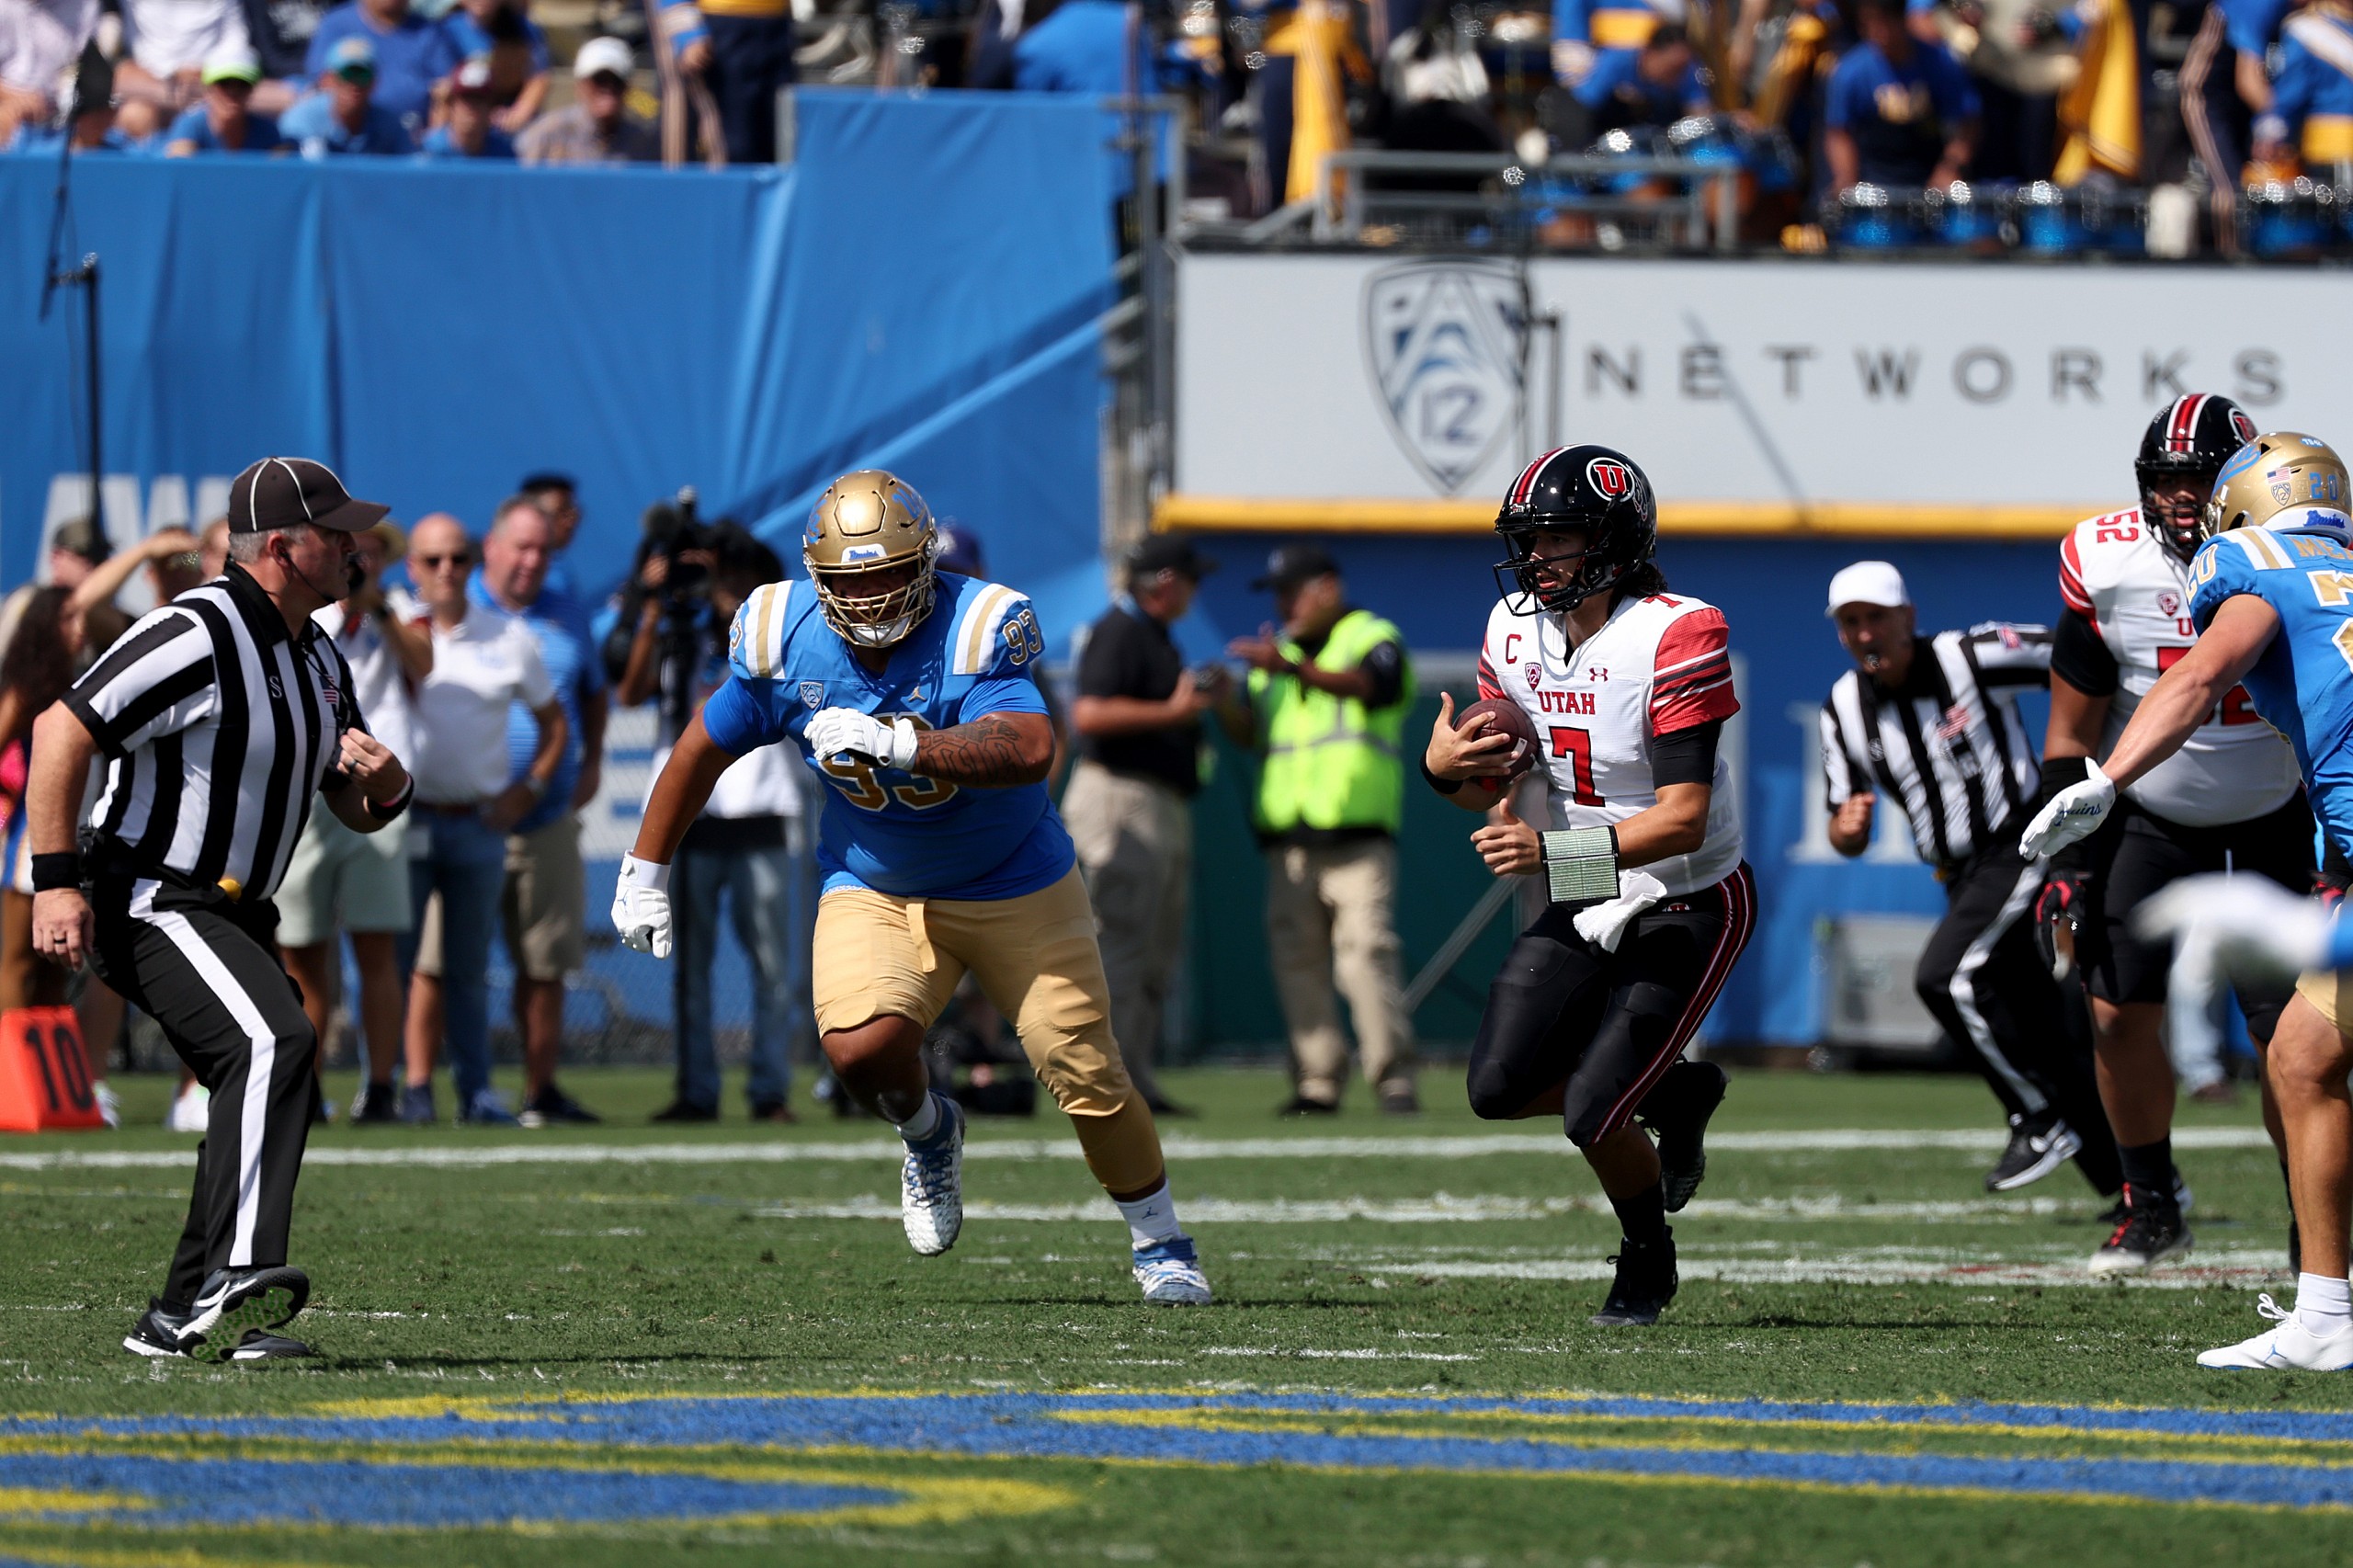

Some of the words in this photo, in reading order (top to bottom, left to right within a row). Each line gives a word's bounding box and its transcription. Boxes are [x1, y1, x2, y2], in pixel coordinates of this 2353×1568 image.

[1585, 344, 2285, 406] NETWORKS
[1593, 464, 1626, 496] U
[2309, 472, 2338, 501] 20
[2277, 492, 2288, 501] 12
[2097, 510, 2140, 544] 52
[2302, 510, 2345, 528] Bruins
[1003, 608, 1041, 665] 93
[1506, 634, 1521, 664] C
[1529, 674, 1539, 685] 12
[1537, 690, 1596, 714] UTAH
[1549, 726, 1606, 807] 7
[25, 1023, 93, 1111] 10
